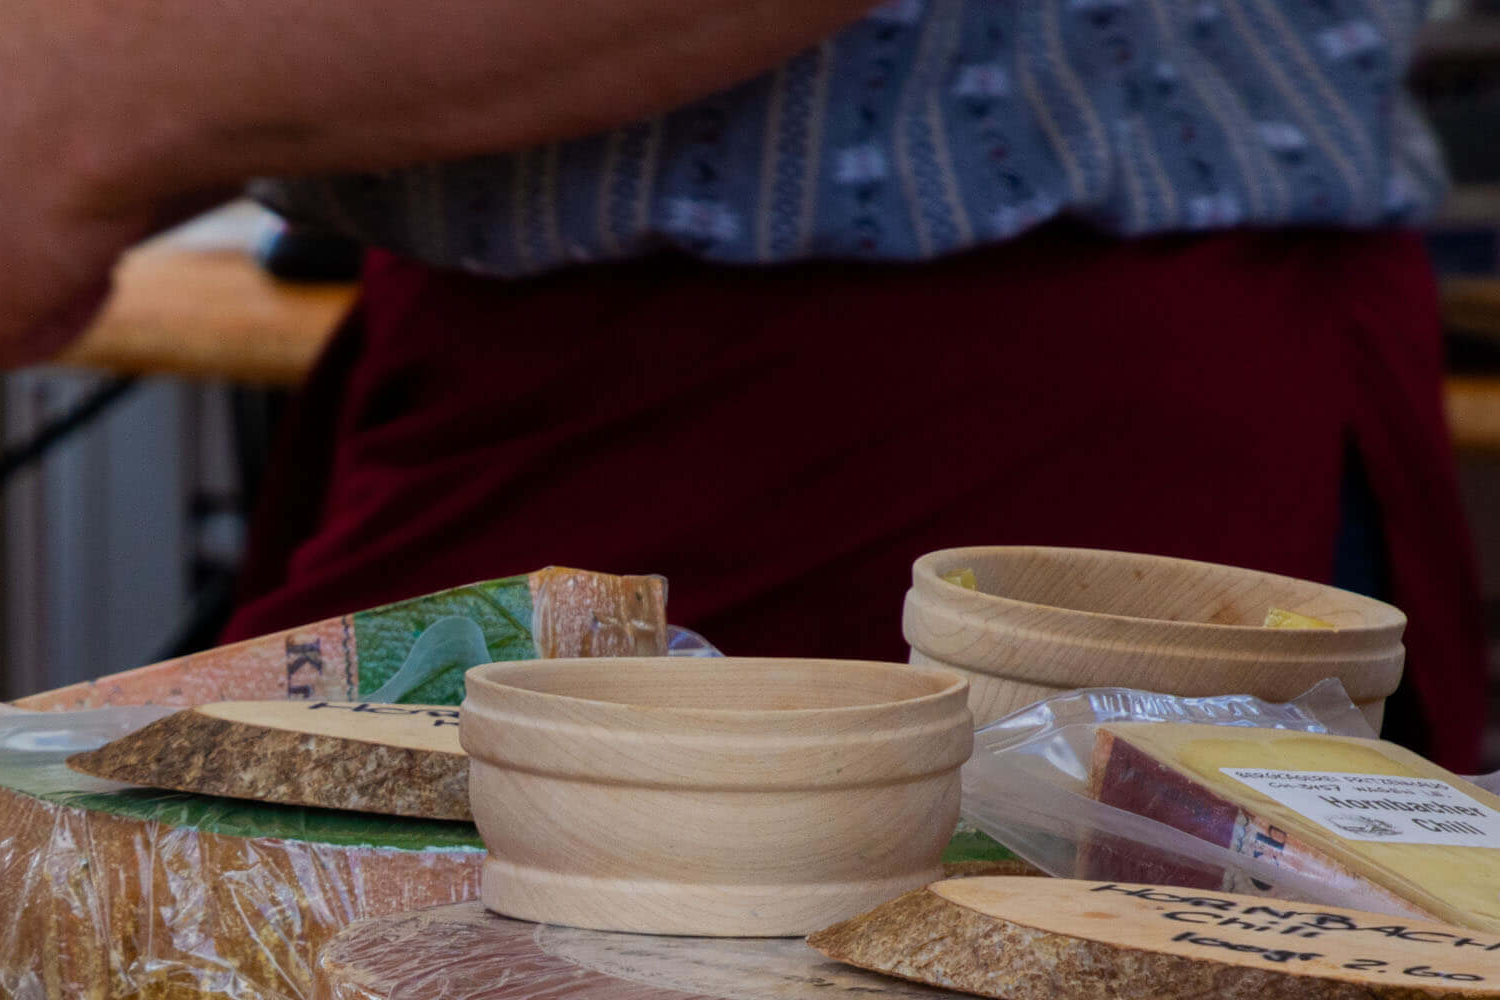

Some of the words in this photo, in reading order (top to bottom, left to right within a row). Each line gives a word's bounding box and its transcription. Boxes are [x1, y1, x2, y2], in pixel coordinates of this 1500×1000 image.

[1319, 795, 1487, 818] Hornbacher
[1411, 817, 1487, 836] Chili
[1162, 910, 1323, 938] Chili
[1344, 958, 1486, 982] 2.60
